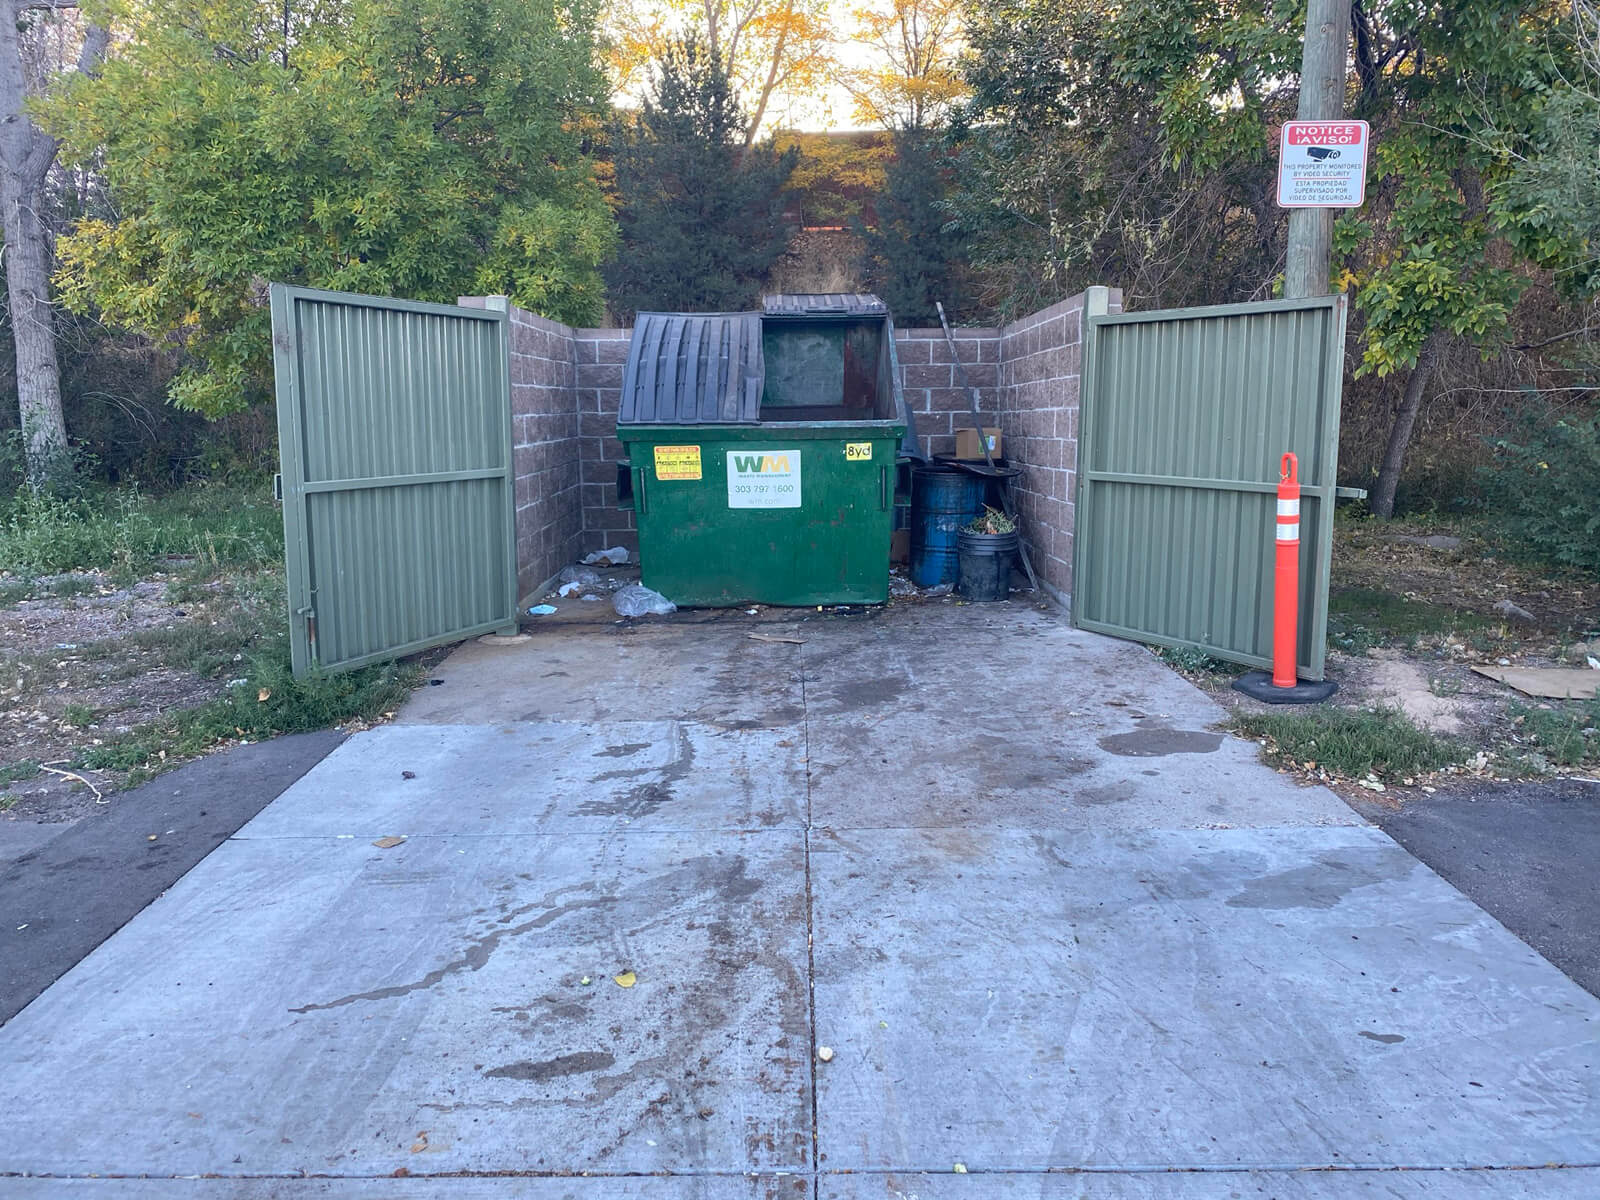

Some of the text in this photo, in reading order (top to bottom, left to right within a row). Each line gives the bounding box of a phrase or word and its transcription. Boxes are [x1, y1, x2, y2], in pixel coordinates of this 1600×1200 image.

[1296, 126, 1354, 135] NOTICE
[1297, 135, 1352, 144] ¡AVISO!
[848, 445, 870, 458] 8yd
[734, 456, 790, 473] WM
[735, 485, 751, 493] 303
